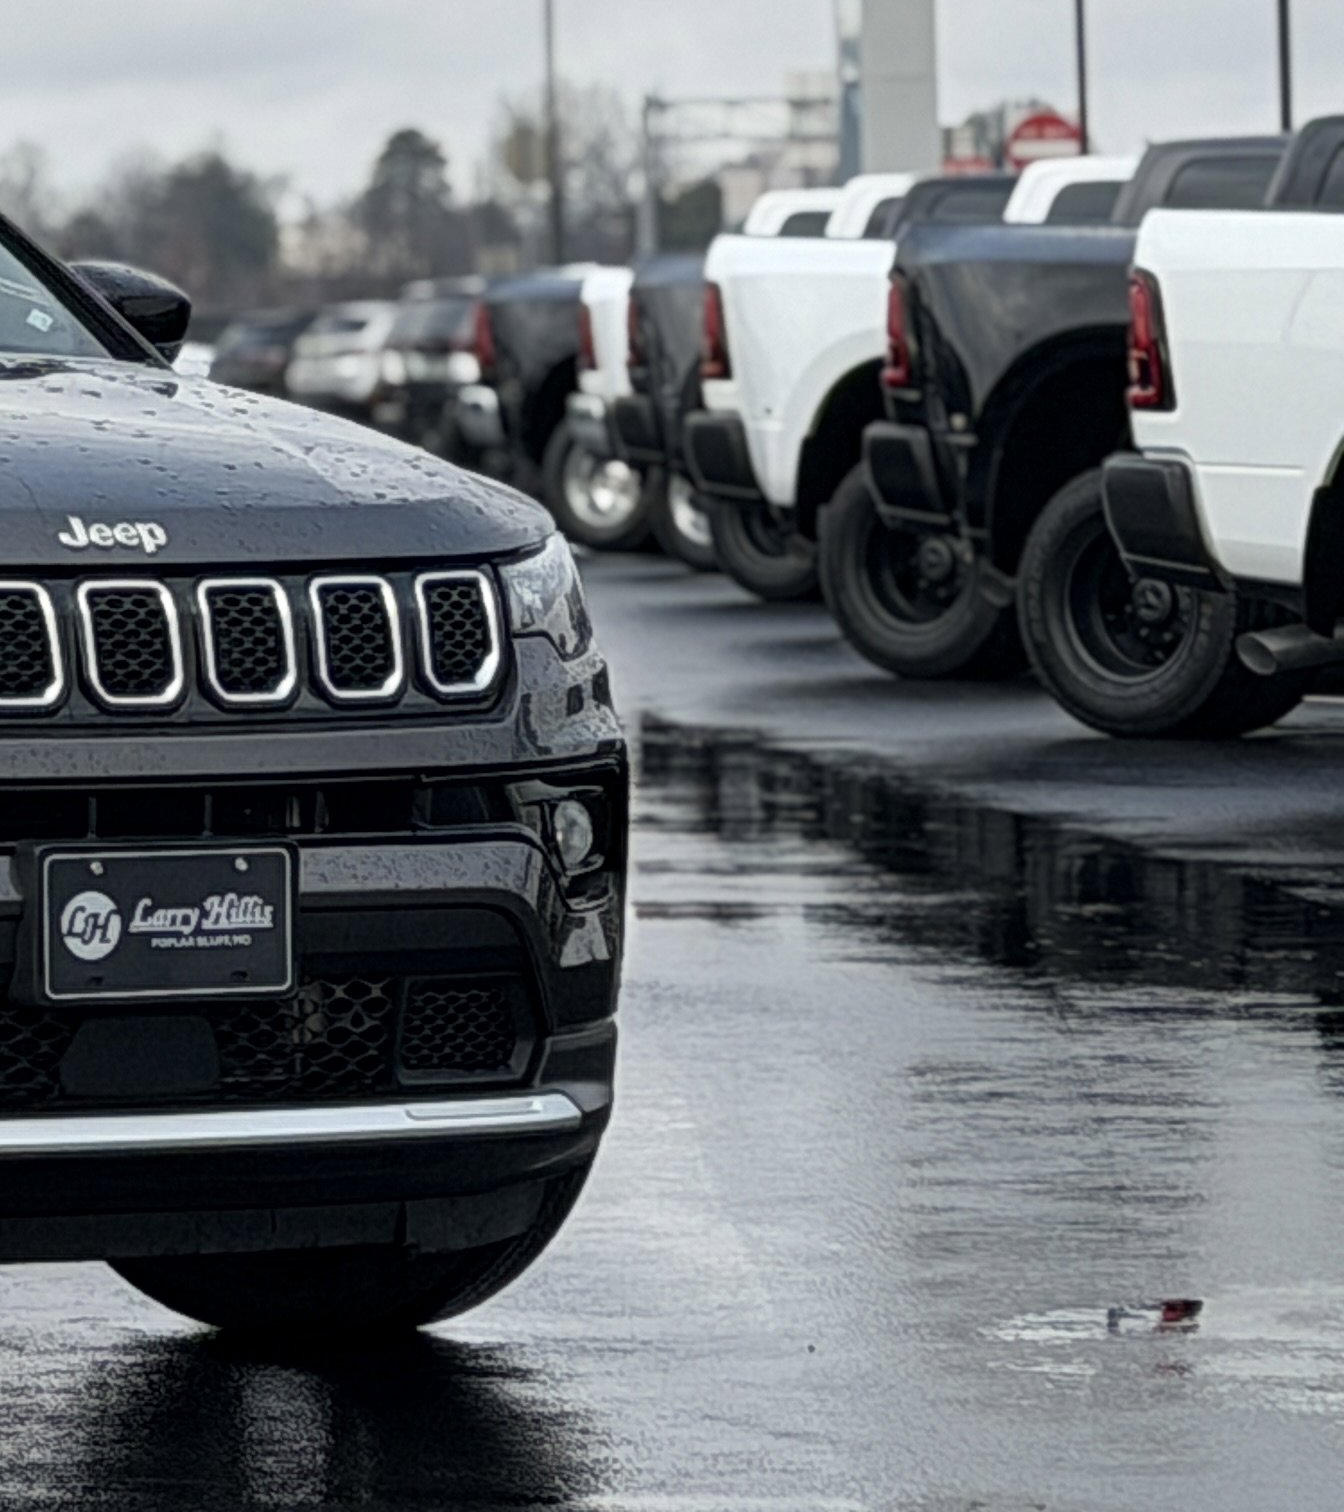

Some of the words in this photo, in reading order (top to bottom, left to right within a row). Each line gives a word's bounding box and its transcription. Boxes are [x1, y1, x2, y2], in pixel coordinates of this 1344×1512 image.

[58, 514, 168, 554] Jeep
[128, 897, 200, 935] Larry
[200, 892, 274, 930] Hillis
